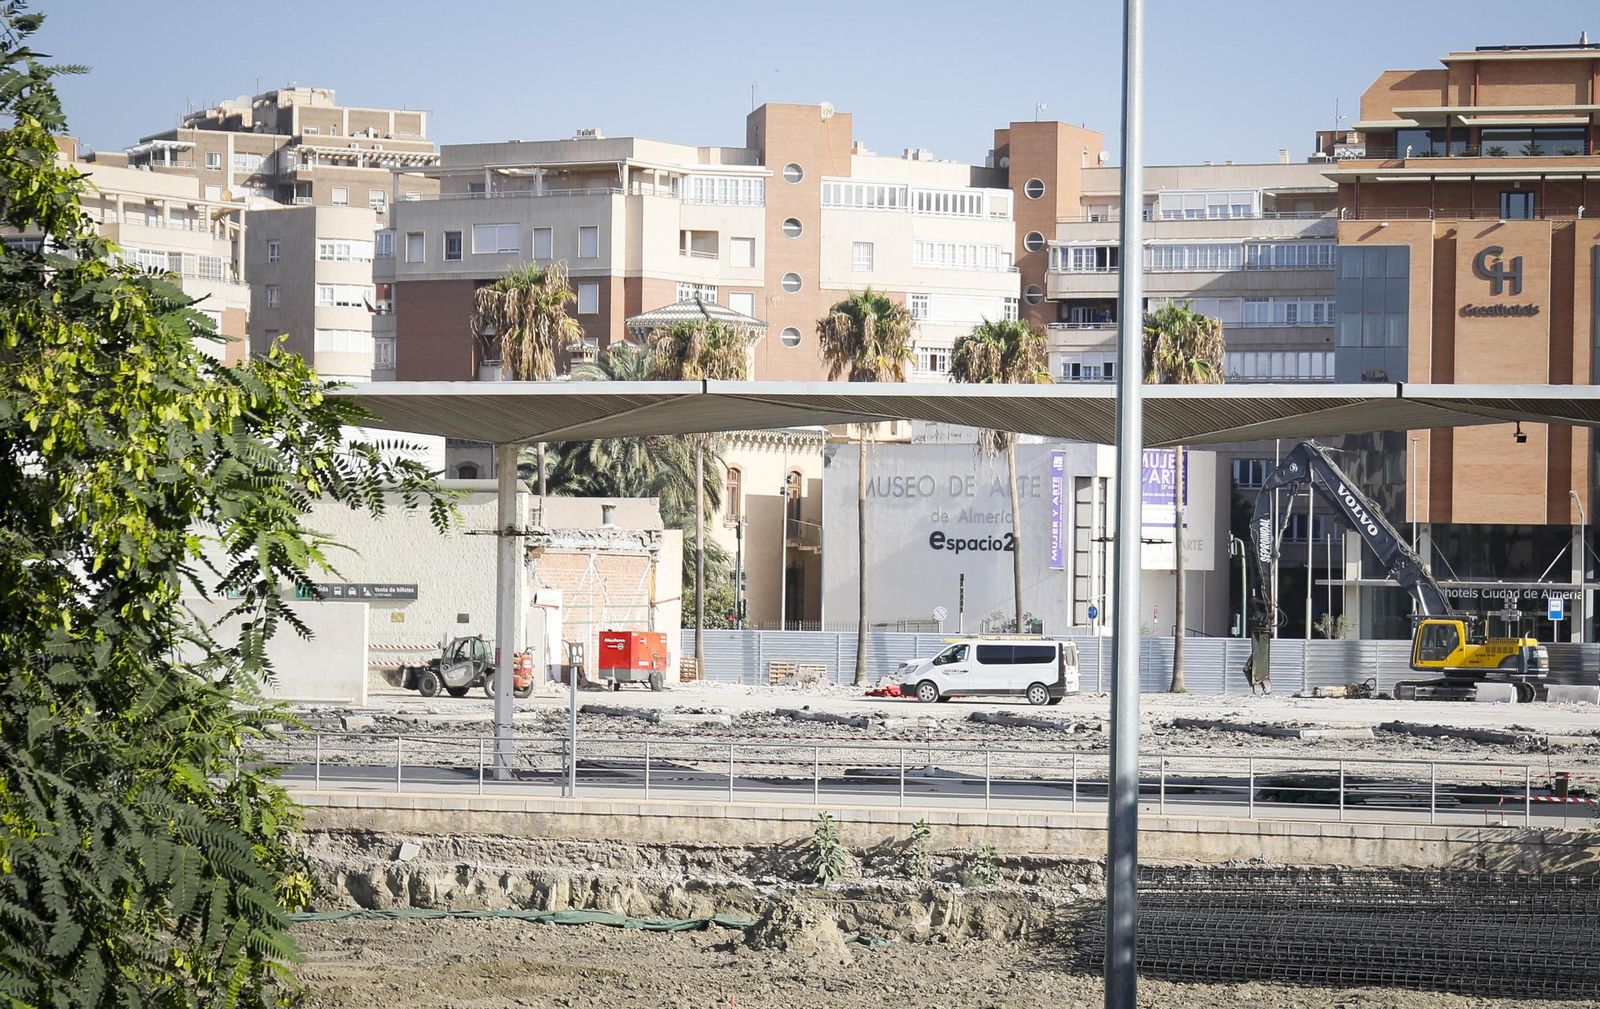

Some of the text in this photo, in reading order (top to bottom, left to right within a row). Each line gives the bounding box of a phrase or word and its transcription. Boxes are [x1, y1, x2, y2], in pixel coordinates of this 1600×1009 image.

[1460, 303, 1540, 318] Greathotels
[949, 475, 976, 498] DE
[989, 475, 1041, 498] ATE
[1051, 476, 1060, 506] ARTE
[931, 508, 949, 524] de
[1337, 482, 1379, 536] VOLVO
[929, 531, 1015, 554] espacio2
[1051, 520, 1059, 561] MUJER
[1524, 588, 1539, 599] de
